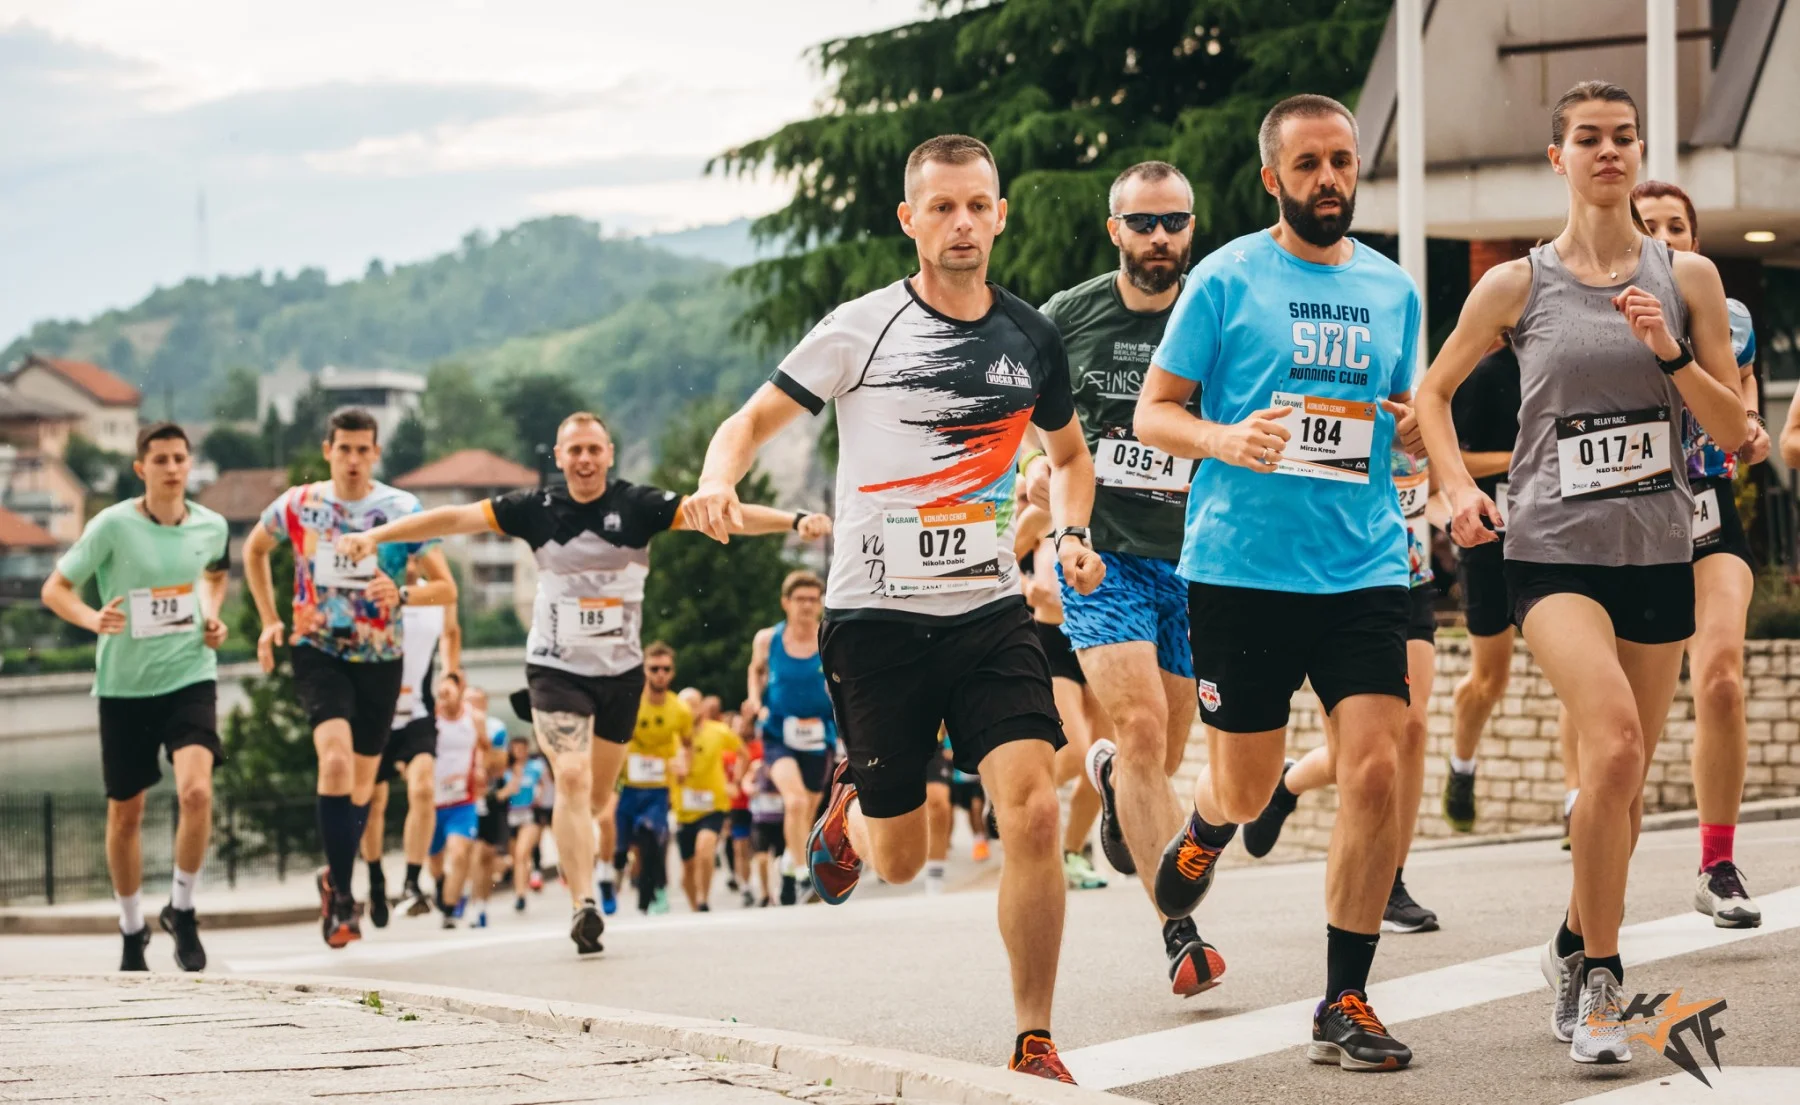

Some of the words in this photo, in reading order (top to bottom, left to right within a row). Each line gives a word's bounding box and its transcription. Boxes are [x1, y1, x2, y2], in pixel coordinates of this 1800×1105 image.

[1289, 302, 1370, 324] SARAJEVO
[1113, 341, 1138, 350] BMW
[1292, 321, 1371, 370] SRC
[1112, 355, 1149, 363] MARATHON
[1083, 369, 1147, 394] FINIS
[1289, 367, 1336, 383] RUNNING
[1339, 370, 1368, 386] CLUB
[1593, 416, 1611, 426] RELAY
[1611, 415, 1627, 425] RACE
[1301, 416, 1342, 446] 184
[1579, 432, 1653, 466] 017-A
[1113, 443, 1174, 477] 035-A
[895, 516, 919, 524] GRAWE
[919, 528, 967, 558] 072
[946, 558, 965, 566] Dabić
[150, 598, 178, 616] 270
[579, 610, 605, 625] 185
